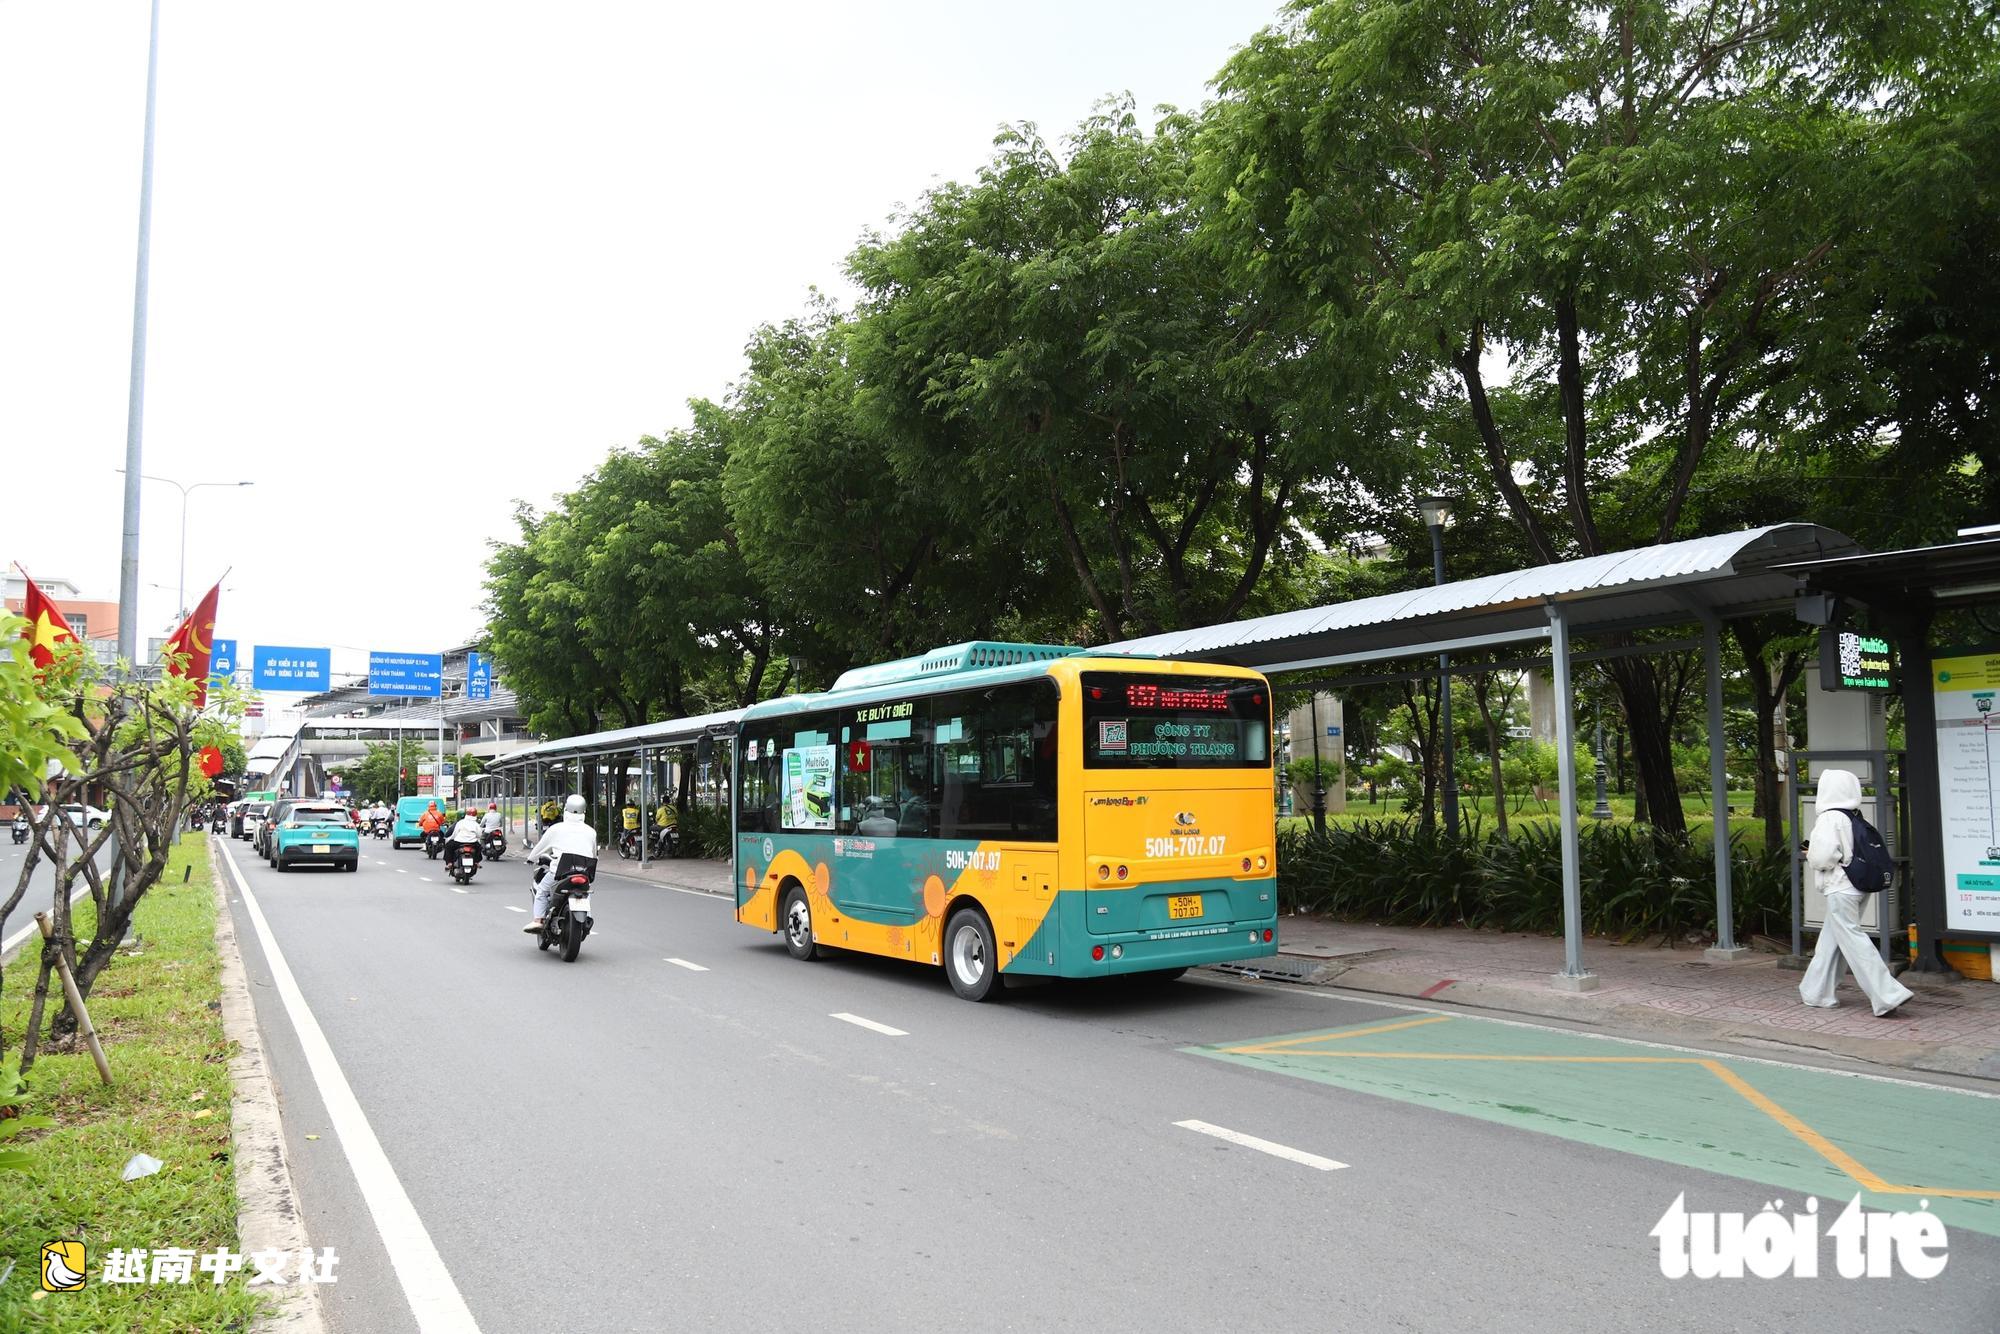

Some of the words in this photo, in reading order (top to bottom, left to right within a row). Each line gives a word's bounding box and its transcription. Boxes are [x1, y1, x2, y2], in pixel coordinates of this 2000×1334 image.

[1860, 638, 1888, 654] MultiGo
[856, 710, 868, 722] XE
[868, 704, 892, 720] BUÝT
[892, 702, 913, 718] ĐIỆN
[1154, 722, 1190, 737] CÔNG
[1193, 725, 1211, 737] TY
[1130, 740, 1187, 755] PHƯƠNG
[1190, 743, 1235, 756] TRANG
[805, 756, 830, 768] MultiGo
[1145, 836, 1226, 858] 50H-707.07
[946, 850, 1000, 870] 50H-707.07
[1178, 897, 1192, 907] 50H
[1173, 906, 1199, 918] 707.07
